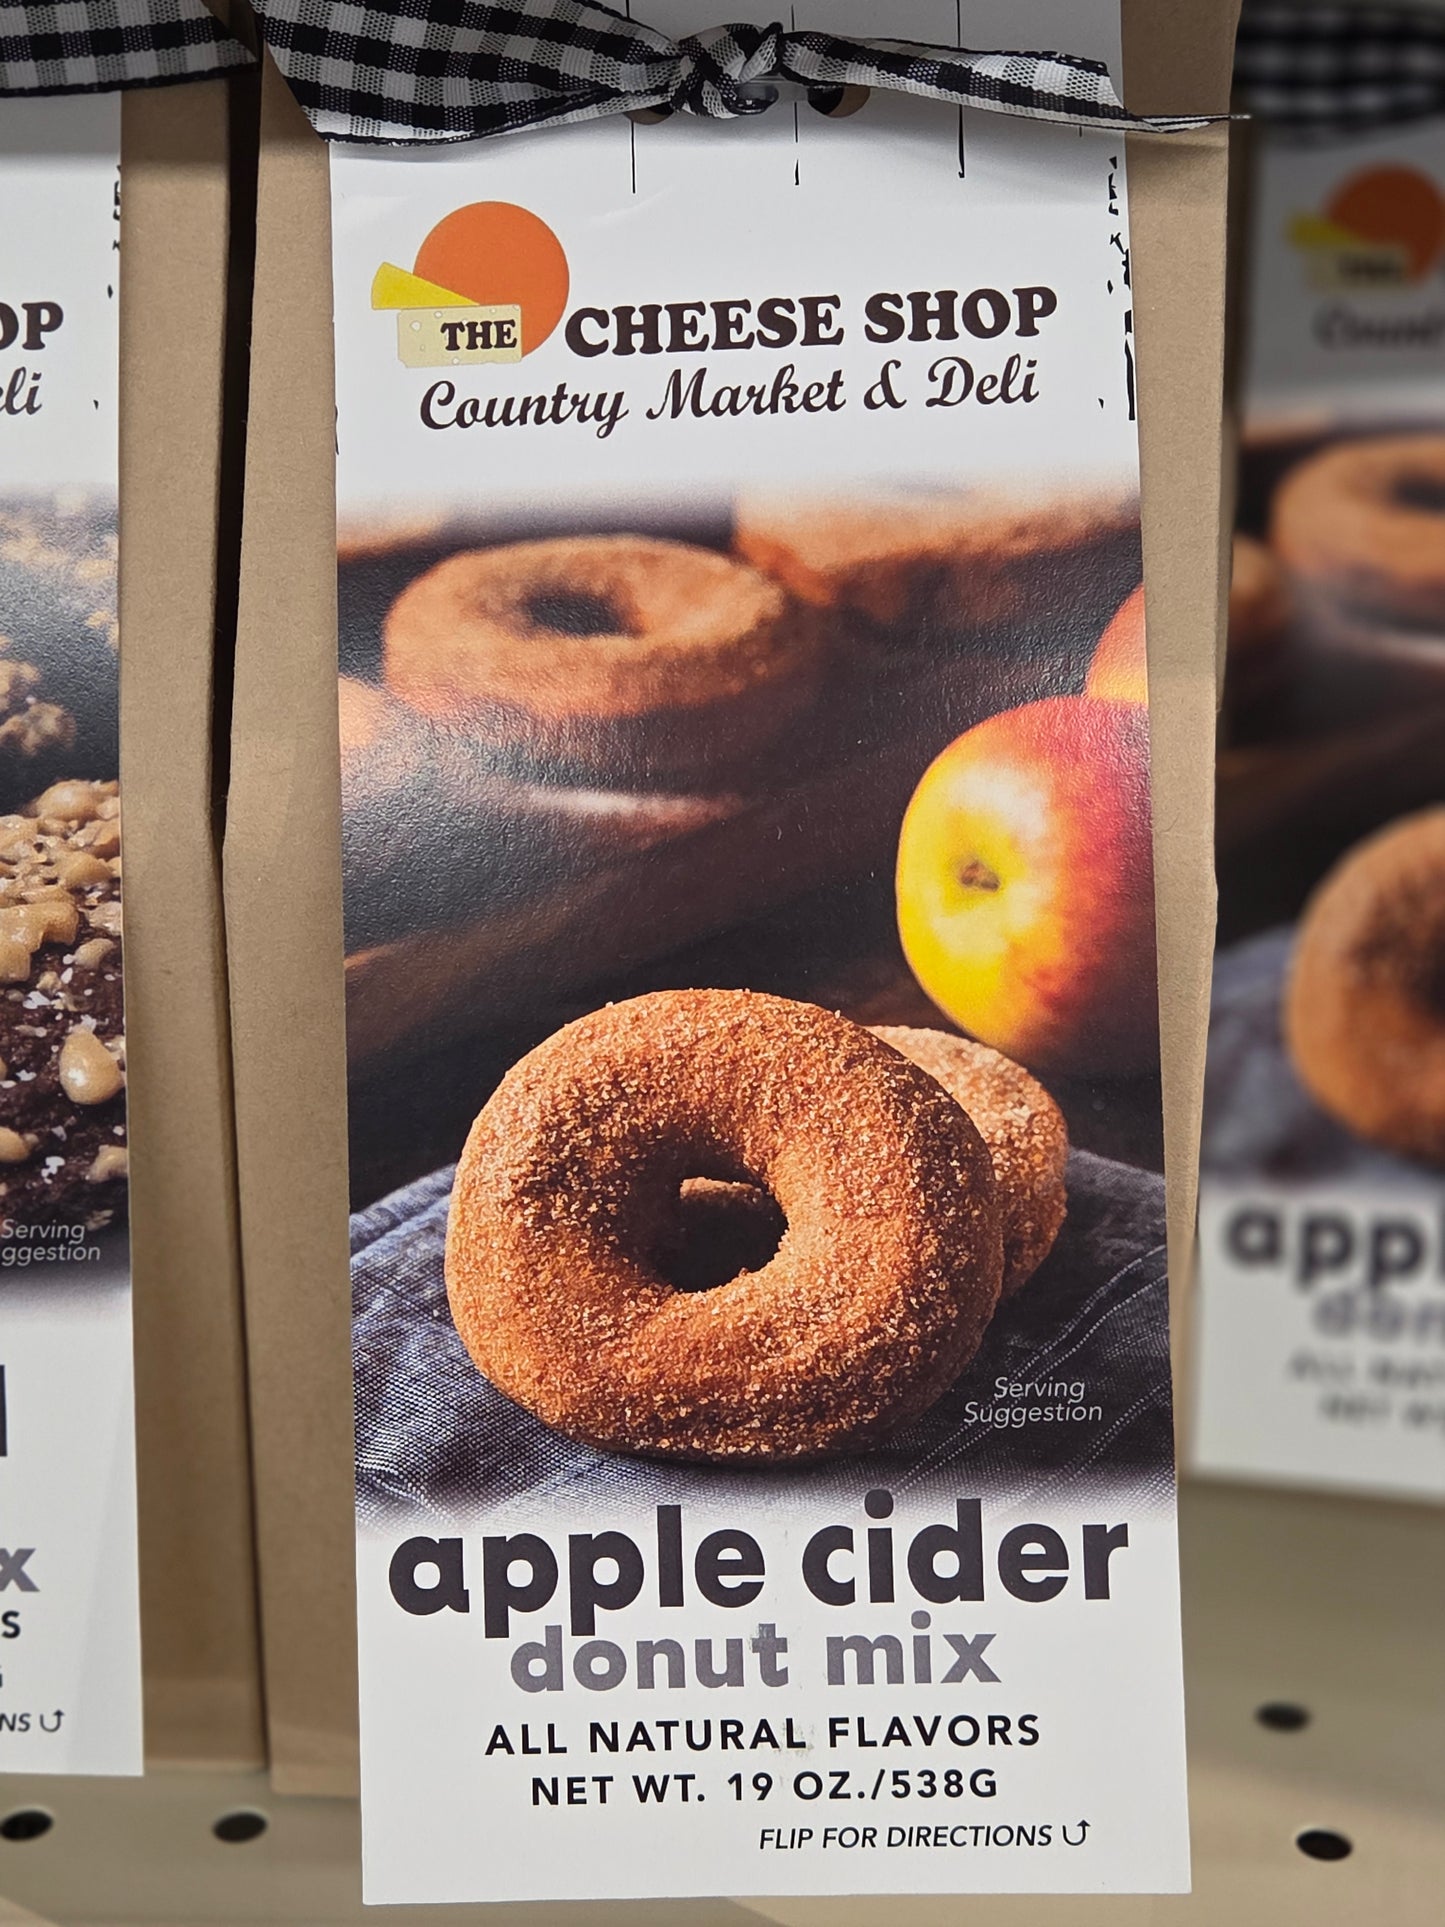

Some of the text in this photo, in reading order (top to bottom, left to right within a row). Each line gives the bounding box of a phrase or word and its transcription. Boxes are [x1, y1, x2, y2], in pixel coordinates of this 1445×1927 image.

[441, 319, 518, 353] THE
[564, 286, 1058, 358] CHEESE SHOP
[420, 352, 1041, 440] Country Market & Deli
[0, 1218, 86, 1245] Serving
[0, 1243, 101, 1267] ggestion
[994, 1376, 1086, 1404] Serving
[963, 1401, 1103, 1429] Suggestion
[388, 1488, 1129, 1639] apple cider
[509, 1611, 1003, 1693] donut mix
[485, 1714, 1042, 1756] ALL NATURAL FLAVORS
[531, 1768, 998, 1806] NET WT. 19 OZ./538G
[758, 1823, 1054, 1850] FLIP FOR DIRECTIONS
